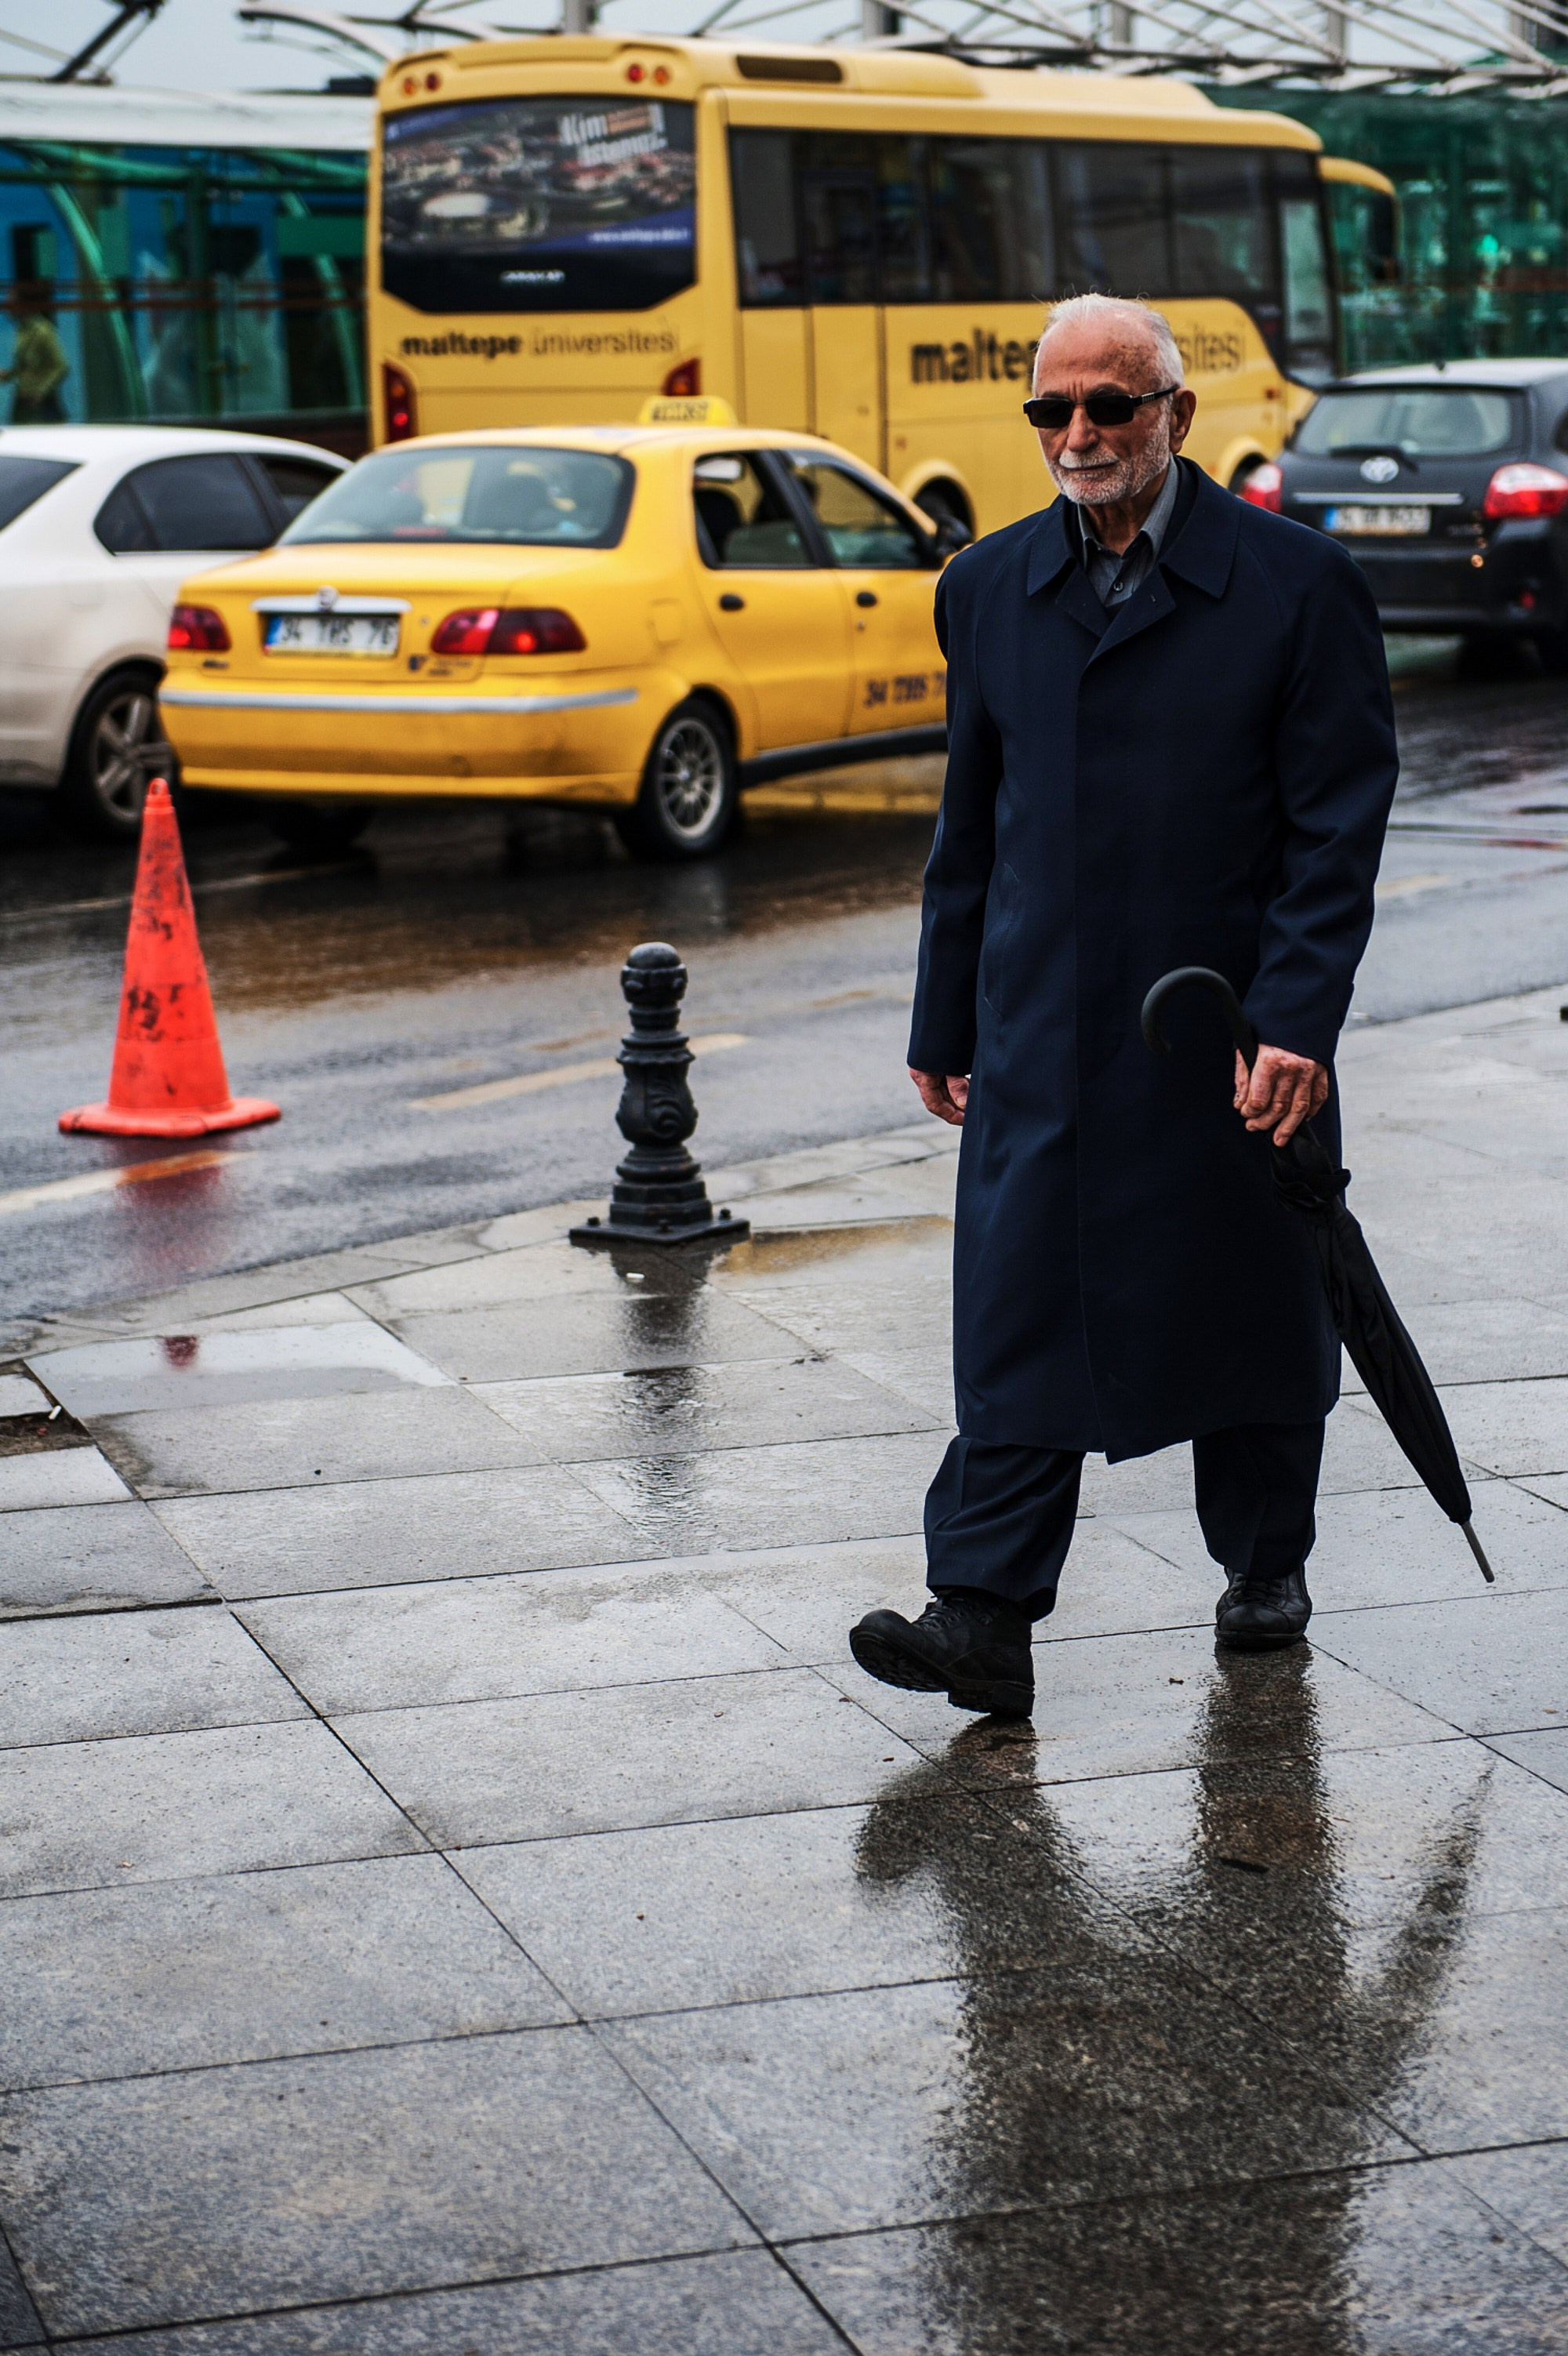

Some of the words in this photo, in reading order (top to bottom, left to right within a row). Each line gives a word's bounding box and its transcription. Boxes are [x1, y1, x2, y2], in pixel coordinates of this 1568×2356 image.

[401, 331, 521, 359] maltepe
[911, 326, 1040, 392] malte
[281, 615, 302, 641] 34
[932, 670, 946, 697] 7
